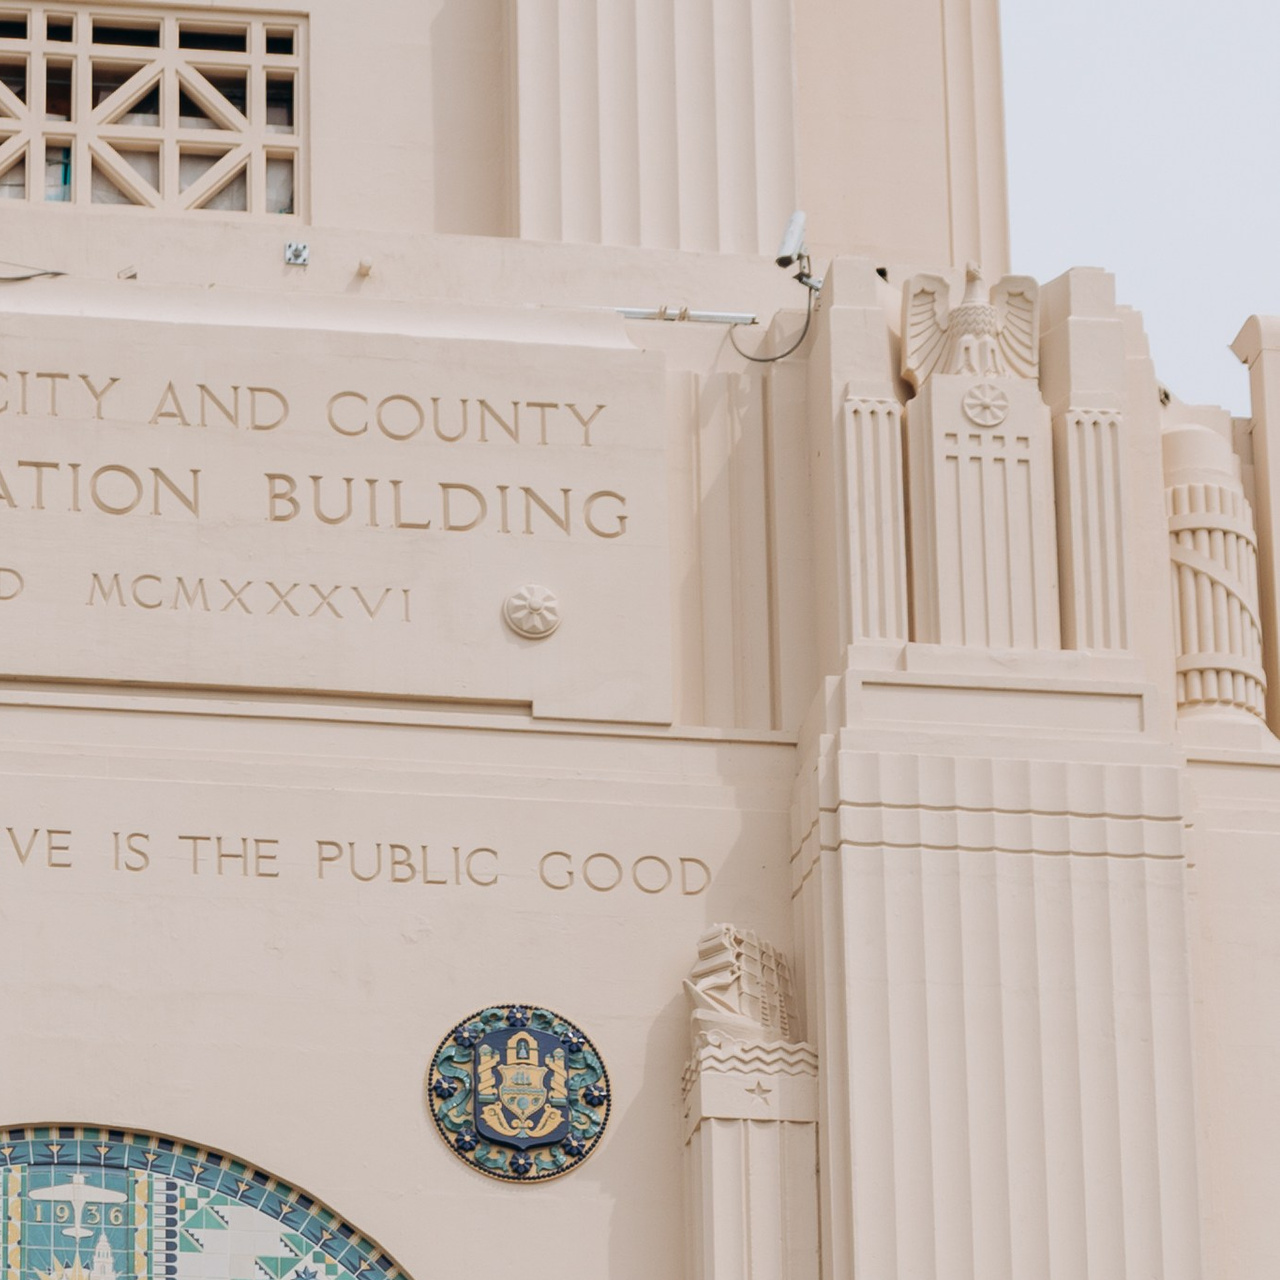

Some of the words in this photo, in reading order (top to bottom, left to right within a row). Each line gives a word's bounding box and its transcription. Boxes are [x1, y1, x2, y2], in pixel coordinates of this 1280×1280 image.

[149, 380, 289, 431] AND
[326, 391, 607, 447] COUNTY
[264, 473, 628, 539] BUILDING
[85, 572, 412, 623] MCMXXXVI
[112, 831, 150, 872] IS
[178, 835, 280, 878] THE
[315, 840, 499, 887] PUBLIC
[538, 850, 712, 896] GOOD
